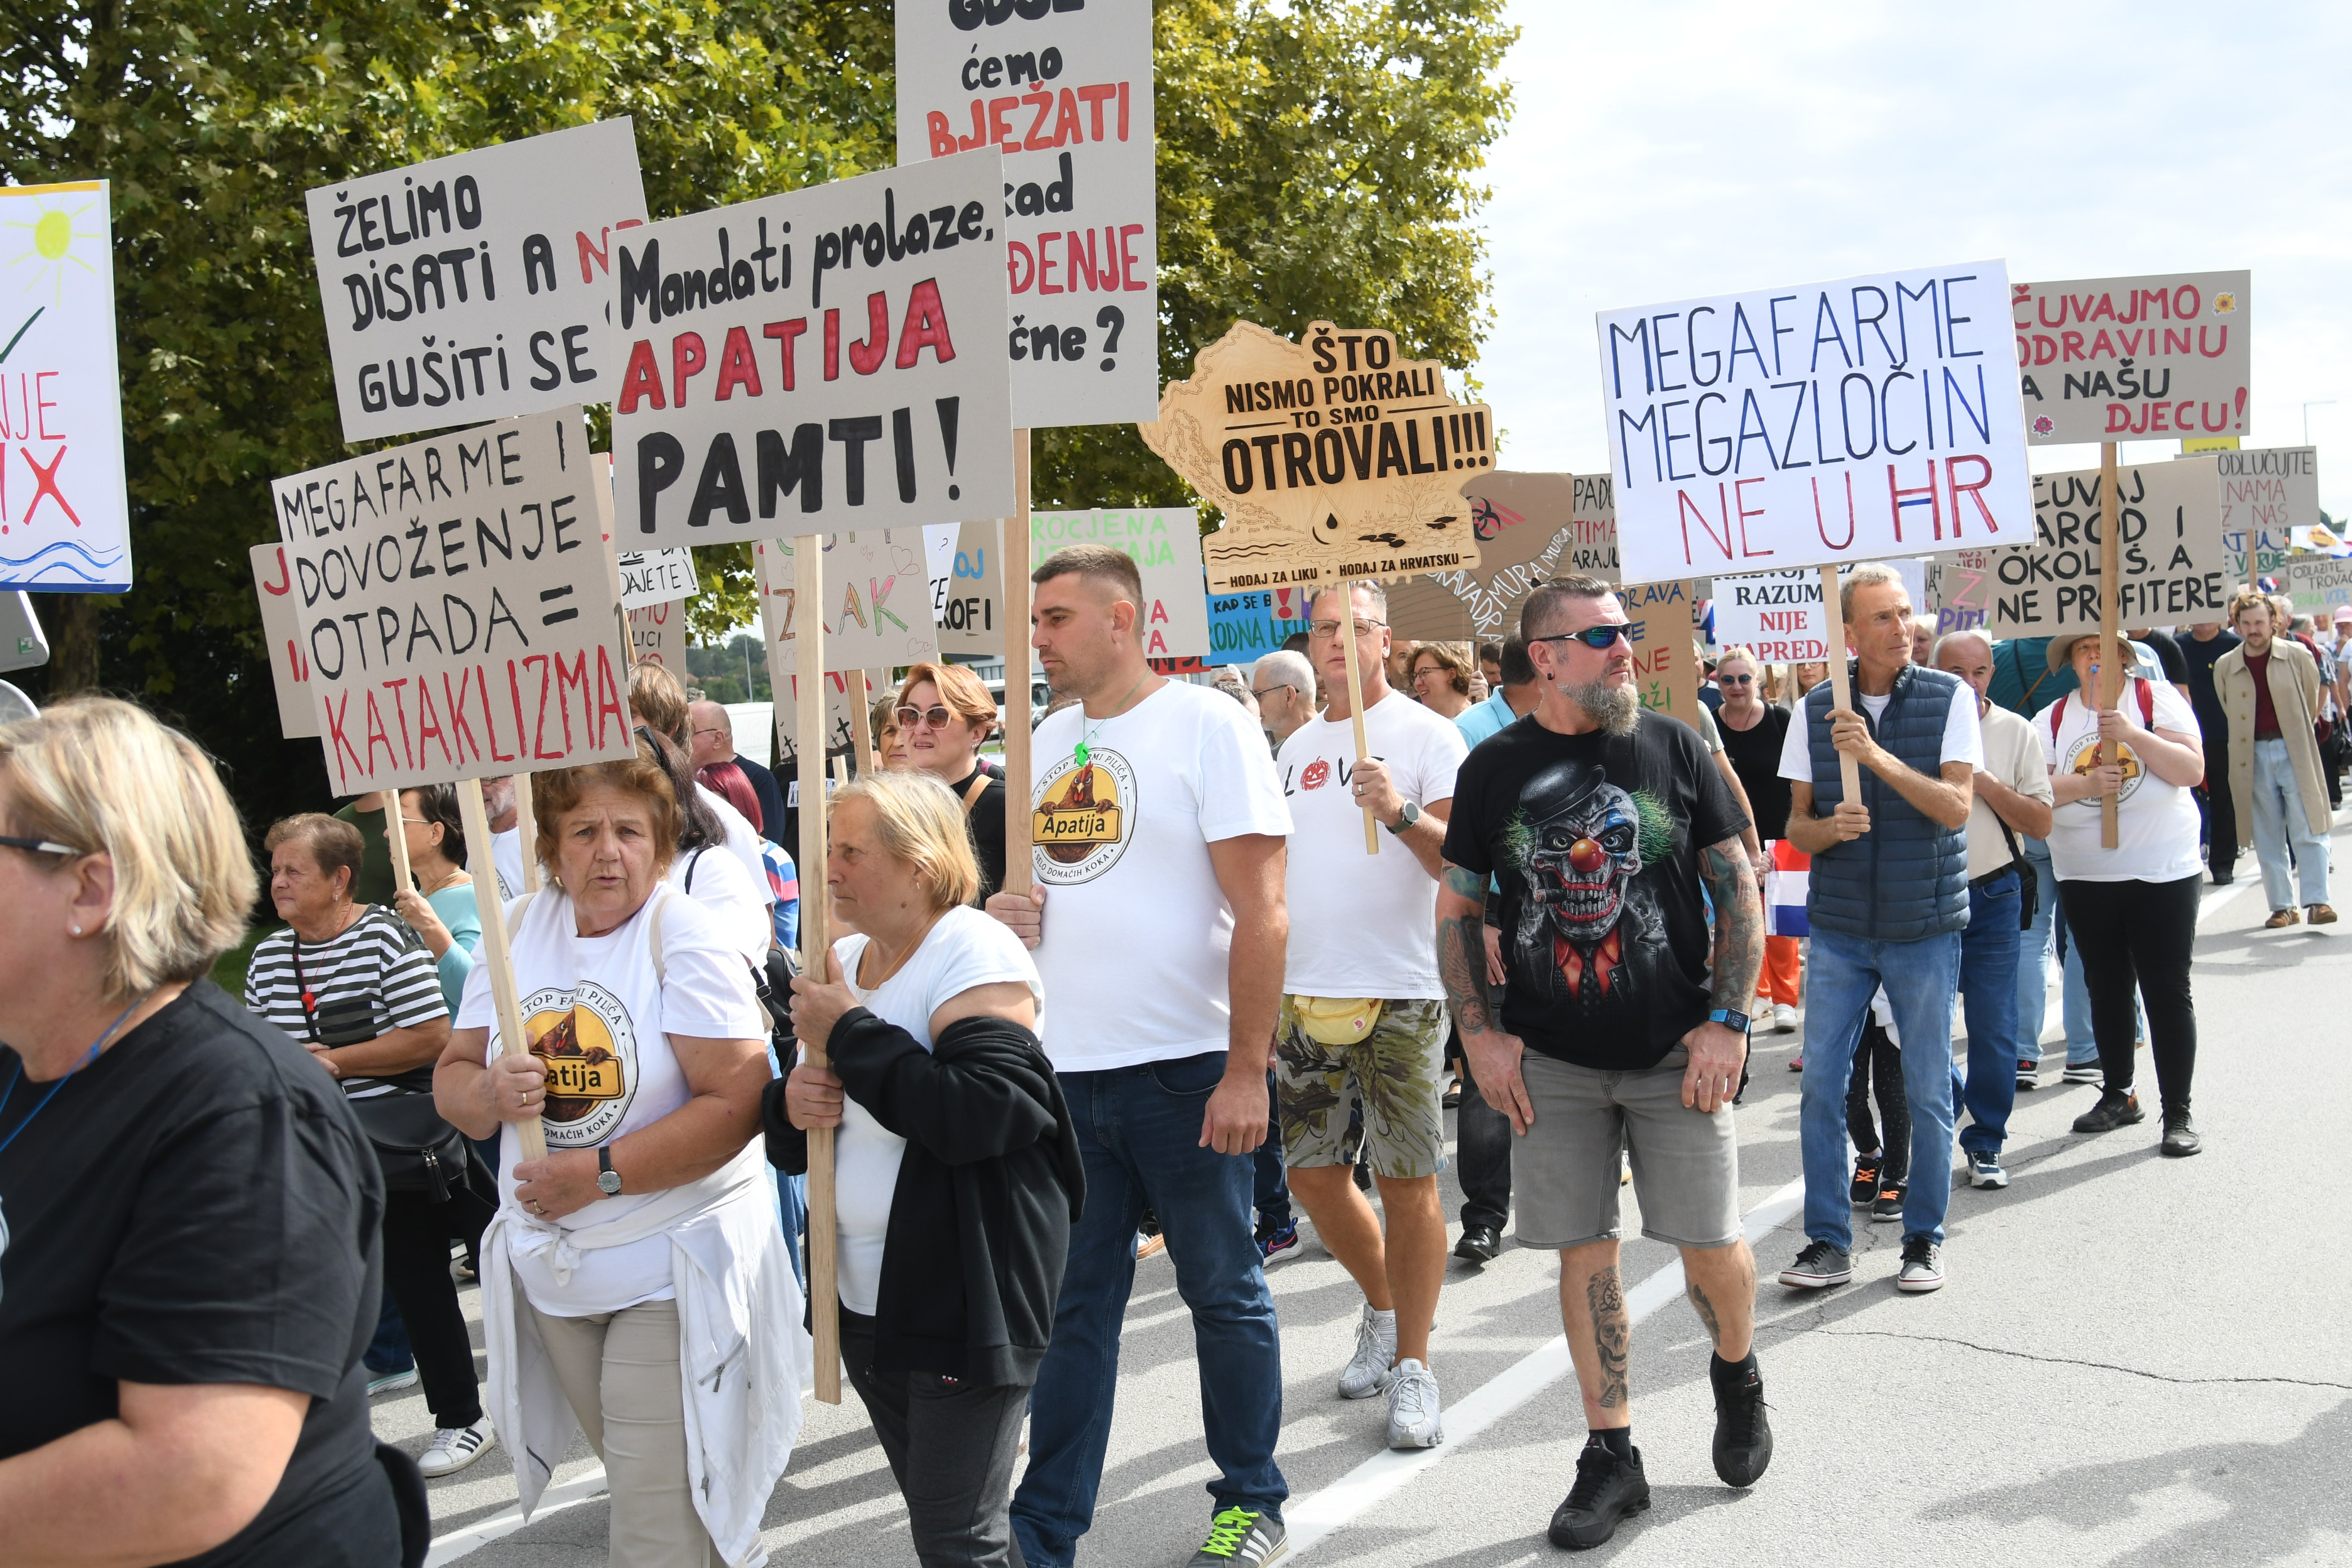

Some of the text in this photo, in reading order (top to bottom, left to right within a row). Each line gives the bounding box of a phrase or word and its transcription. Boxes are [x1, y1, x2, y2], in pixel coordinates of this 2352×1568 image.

[961, 43, 1063, 91] ćemo
[926, 80, 1129, 159] BJEŽATI
[523, 233, 556, 295] A
[576, 219, 643, 284] N
[618, 188, 994, 330] Mandati prolaze,
[2013, 284, 2200, 329] ČUVAJMO
[529, 325, 597, 391] SE
[617, 277, 956, 415] APATIJA
[1312, 328, 1390, 373] ŠTO
[1610, 275, 1983, 399] MEGAFARME
[1225, 367, 1435, 413] NISMO POKRALI
[2064, 358, 2170, 400] NAŠU
[1290, 404, 1379, 427] TO SMO
[1619, 362, 1990, 488] MEGAZLOČIN
[2105, 387, 2247, 434] DJECU!
[1222, 412, 1489, 495] OTROVALI!!!
[2219, 449, 2313, 479] ODLUČUJTE
[281, 420, 565, 543] MEGAFARME I
[2226, 479, 2286, 502] NAMA
[1677, 454, 1998, 567] NE U HR
[2177, 505, 2184, 538] I
[2252, 504, 2288, 525] NAS
[296, 495, 581, 608] DOVOŽENJE
[1230, 553, 1459, 587] HODAJ ZA LIKU HODAJ ZA HRVATSKU
[1540, 527, 1573, 568] MURA
[1998, 543, 2193, 585] OKOLŠ, A
[1214, 599, 1239, 614] KAD
[1243, 595, 1258, 609] SE
[1486, 561, 1551, 610] MURA
[1998, 590, 2042, 625] NE
[773, 575, 908, 642] ZAK
[1759, 611, 1807, 635] NIJE
[311, 586, 528, 680] OTPADA
[324, 644, 629, 794] KATAKLIZMA
[1043, 753, 1128, 787] STOP FRMI PILIĆA
[2069, 741, 2084, 758] STOP
[2119, 783, 2134, 796] KOKA
[1042, 813, 1105, 838] Apatija
[1035, 853, 1110, 878] SELO DOMAĆIH KOKA
[587, 990, 622, 1026] PILIĆA
[586, 1112, 614, 1135] KOKA
